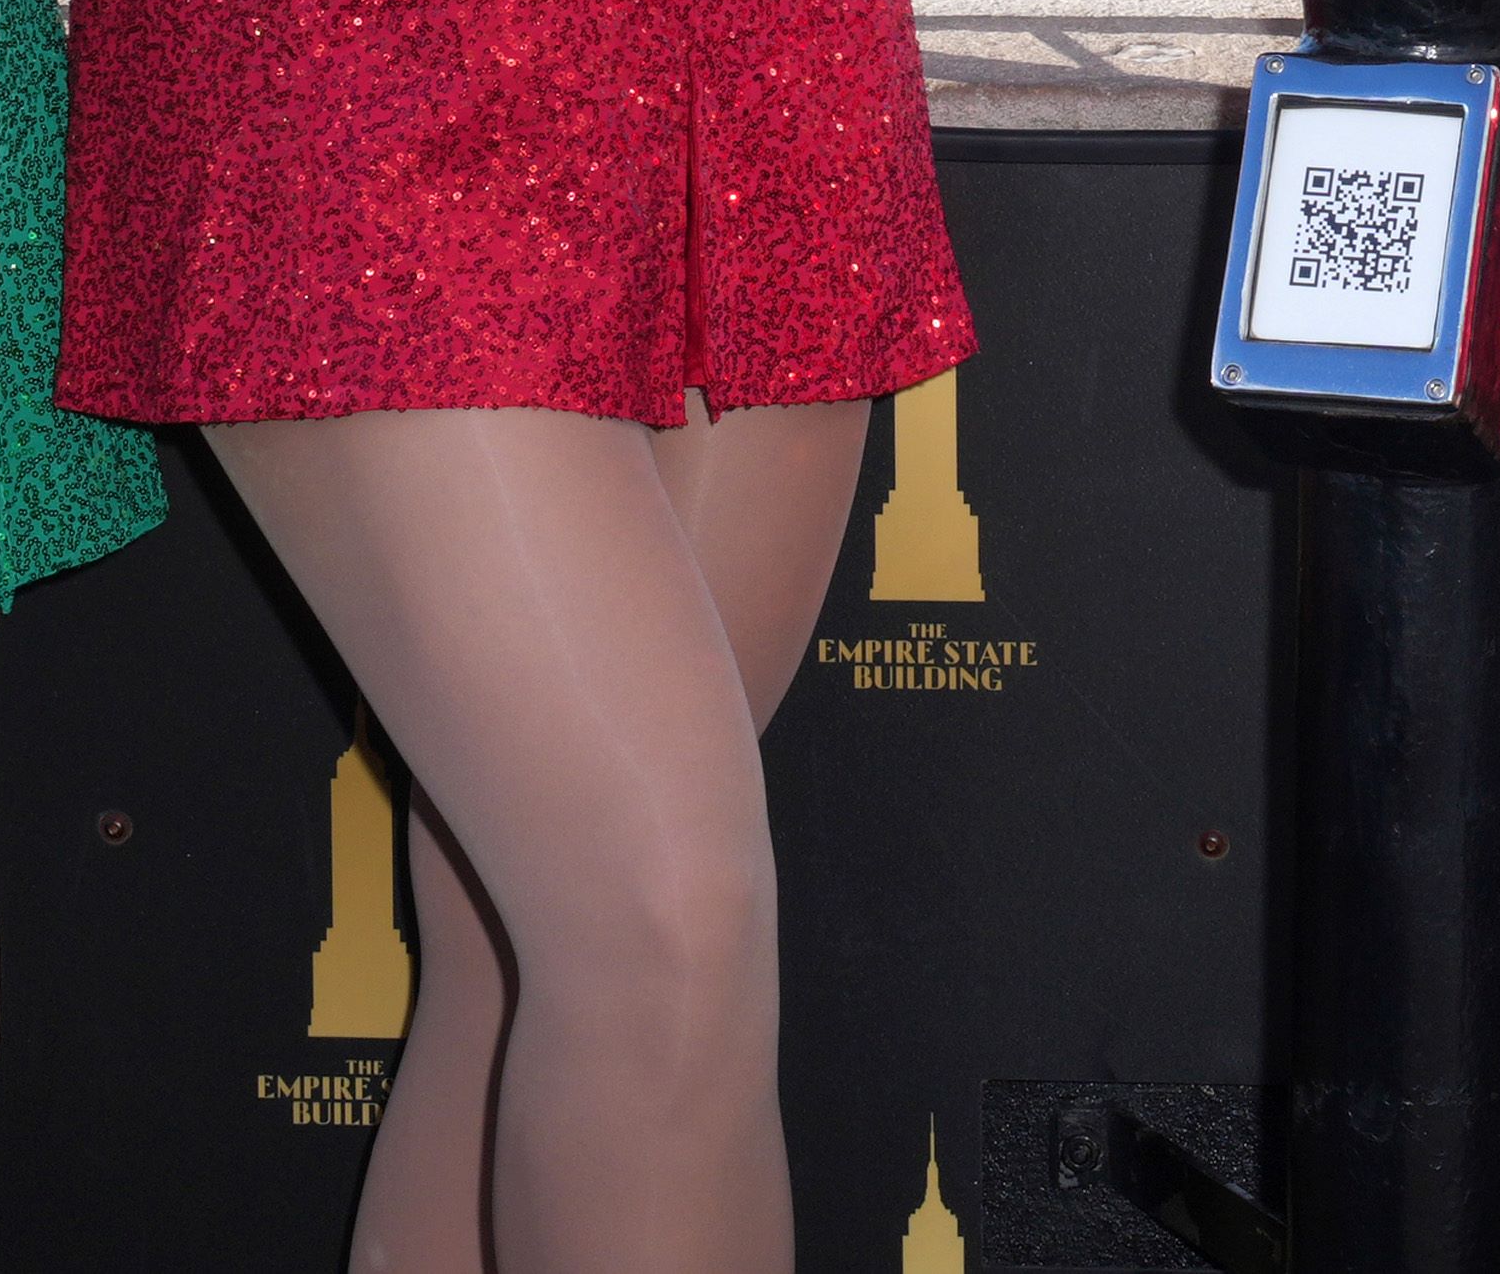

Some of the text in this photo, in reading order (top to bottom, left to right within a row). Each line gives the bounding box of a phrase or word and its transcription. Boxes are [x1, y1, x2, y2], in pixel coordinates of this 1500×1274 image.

[908, 623, 947, 639] THE
[818, 639, 1038, 666] EMPIRE STATE
[853, 665, 1002, 691] BUILDING
[345, 1059, 384, 1076] THE
[257, 1074, 372, 1101] EMPIRE
[292, 1101, 384, 1126] BUILD
